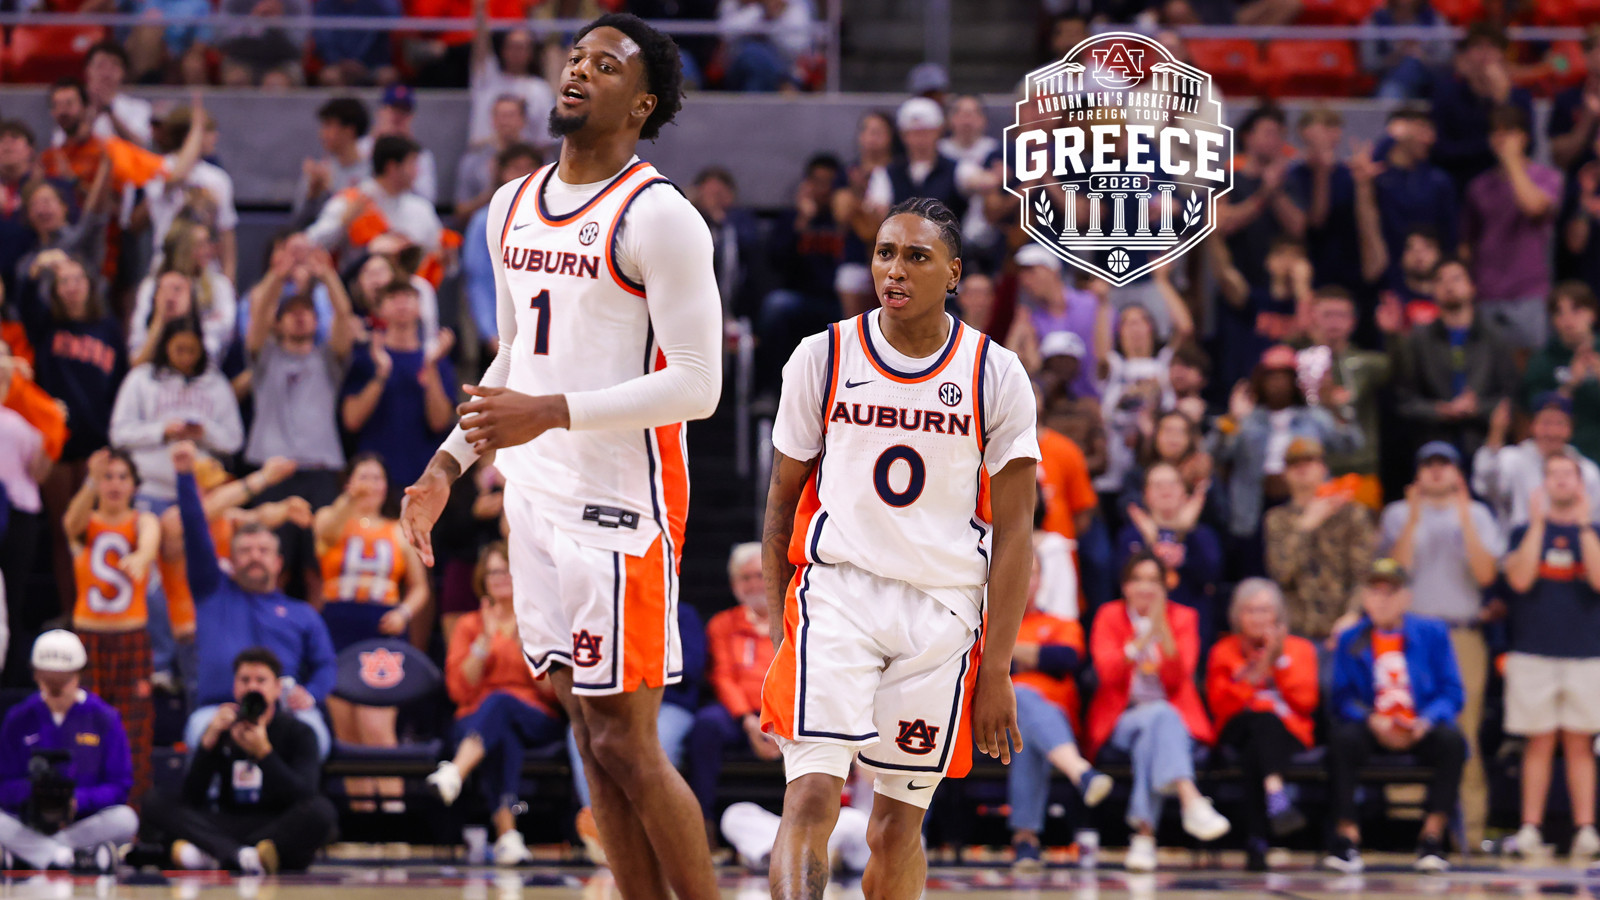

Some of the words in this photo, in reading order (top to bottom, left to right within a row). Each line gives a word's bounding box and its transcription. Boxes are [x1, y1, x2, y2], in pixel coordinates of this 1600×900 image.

[503, 245, 600, 279] AUBURN
[530, 288, 551, 356] 1
[830, 401, 972, 437] AUBURN
[939, 382, 962, 407] SEC
[873, 444, 926, 508] 0
[87, 531, 134, 613] S
[338, 536, 393, 601] H
